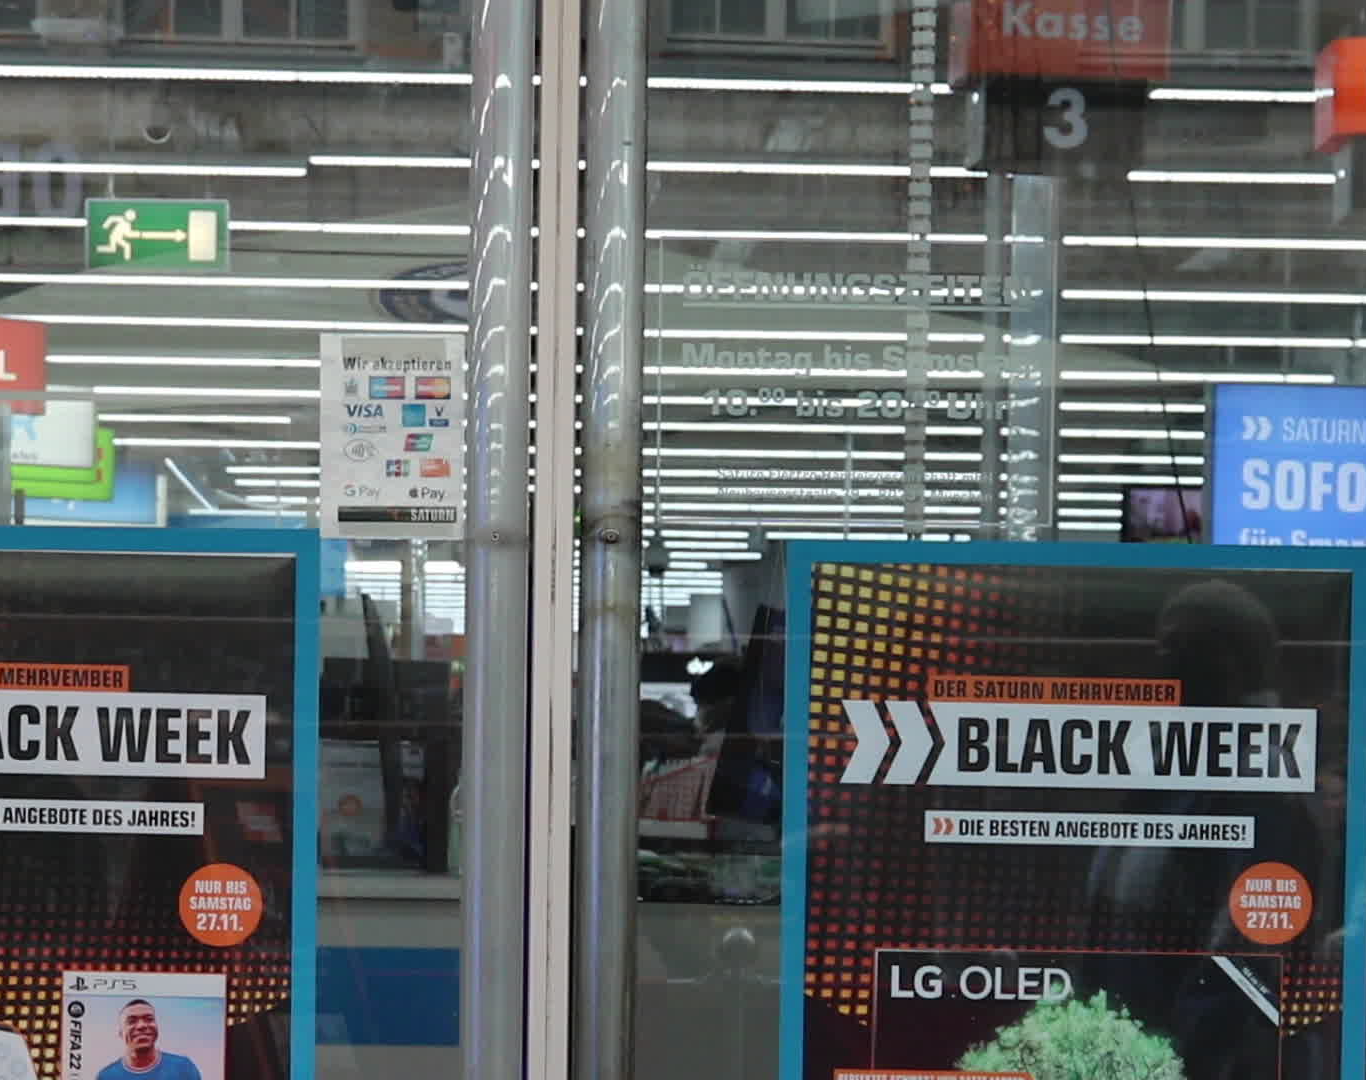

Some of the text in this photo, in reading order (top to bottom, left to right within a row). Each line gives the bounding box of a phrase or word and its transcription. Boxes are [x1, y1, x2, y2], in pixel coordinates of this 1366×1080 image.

[1003, 0, 1145, 40] Kasse
[1044, 88, 1089, 149] 3
[343, 357, 452, 373] Wir akzeptieren
[682, 343, 811, 377] Montag
[824, 345, 871, 369] bis
[346, 404, 384, 418] VISA
[796, 390, 843, 417] bis
[410, 508, 455, 522] SATURN
[935, 678, 1176, 703] DER SATURN MEHRVEMBER
[97, 707, 252, 766] WEEK
[958, 717, 1302, 779] BLACK WEEK
[3, 806, 88, 826] ANGEBOTE
[92, 808, 123, 827] DES
[127, 810, 197, 829] JAHRES!
[958, 818, 1246, 842] DIE BESTEN ANGEBOTE DES JAHRES!
[195, 879, 248, 895] NUR BIS
[1245, 878, 1297, 893] NUR BIS
[189, 894, 252, 912] SAMSTAG
[1239, 893, 1301, 910] SAMSTAG
[196, 912, 244, 931] 27.11.
[1246, 911, 1294, 930] 27.11.
[92, 977, 138, 991] PS5
[890, 964, 1072, 1001] LG OLED
[68, 1019, 83, 1071] FIFA 22
